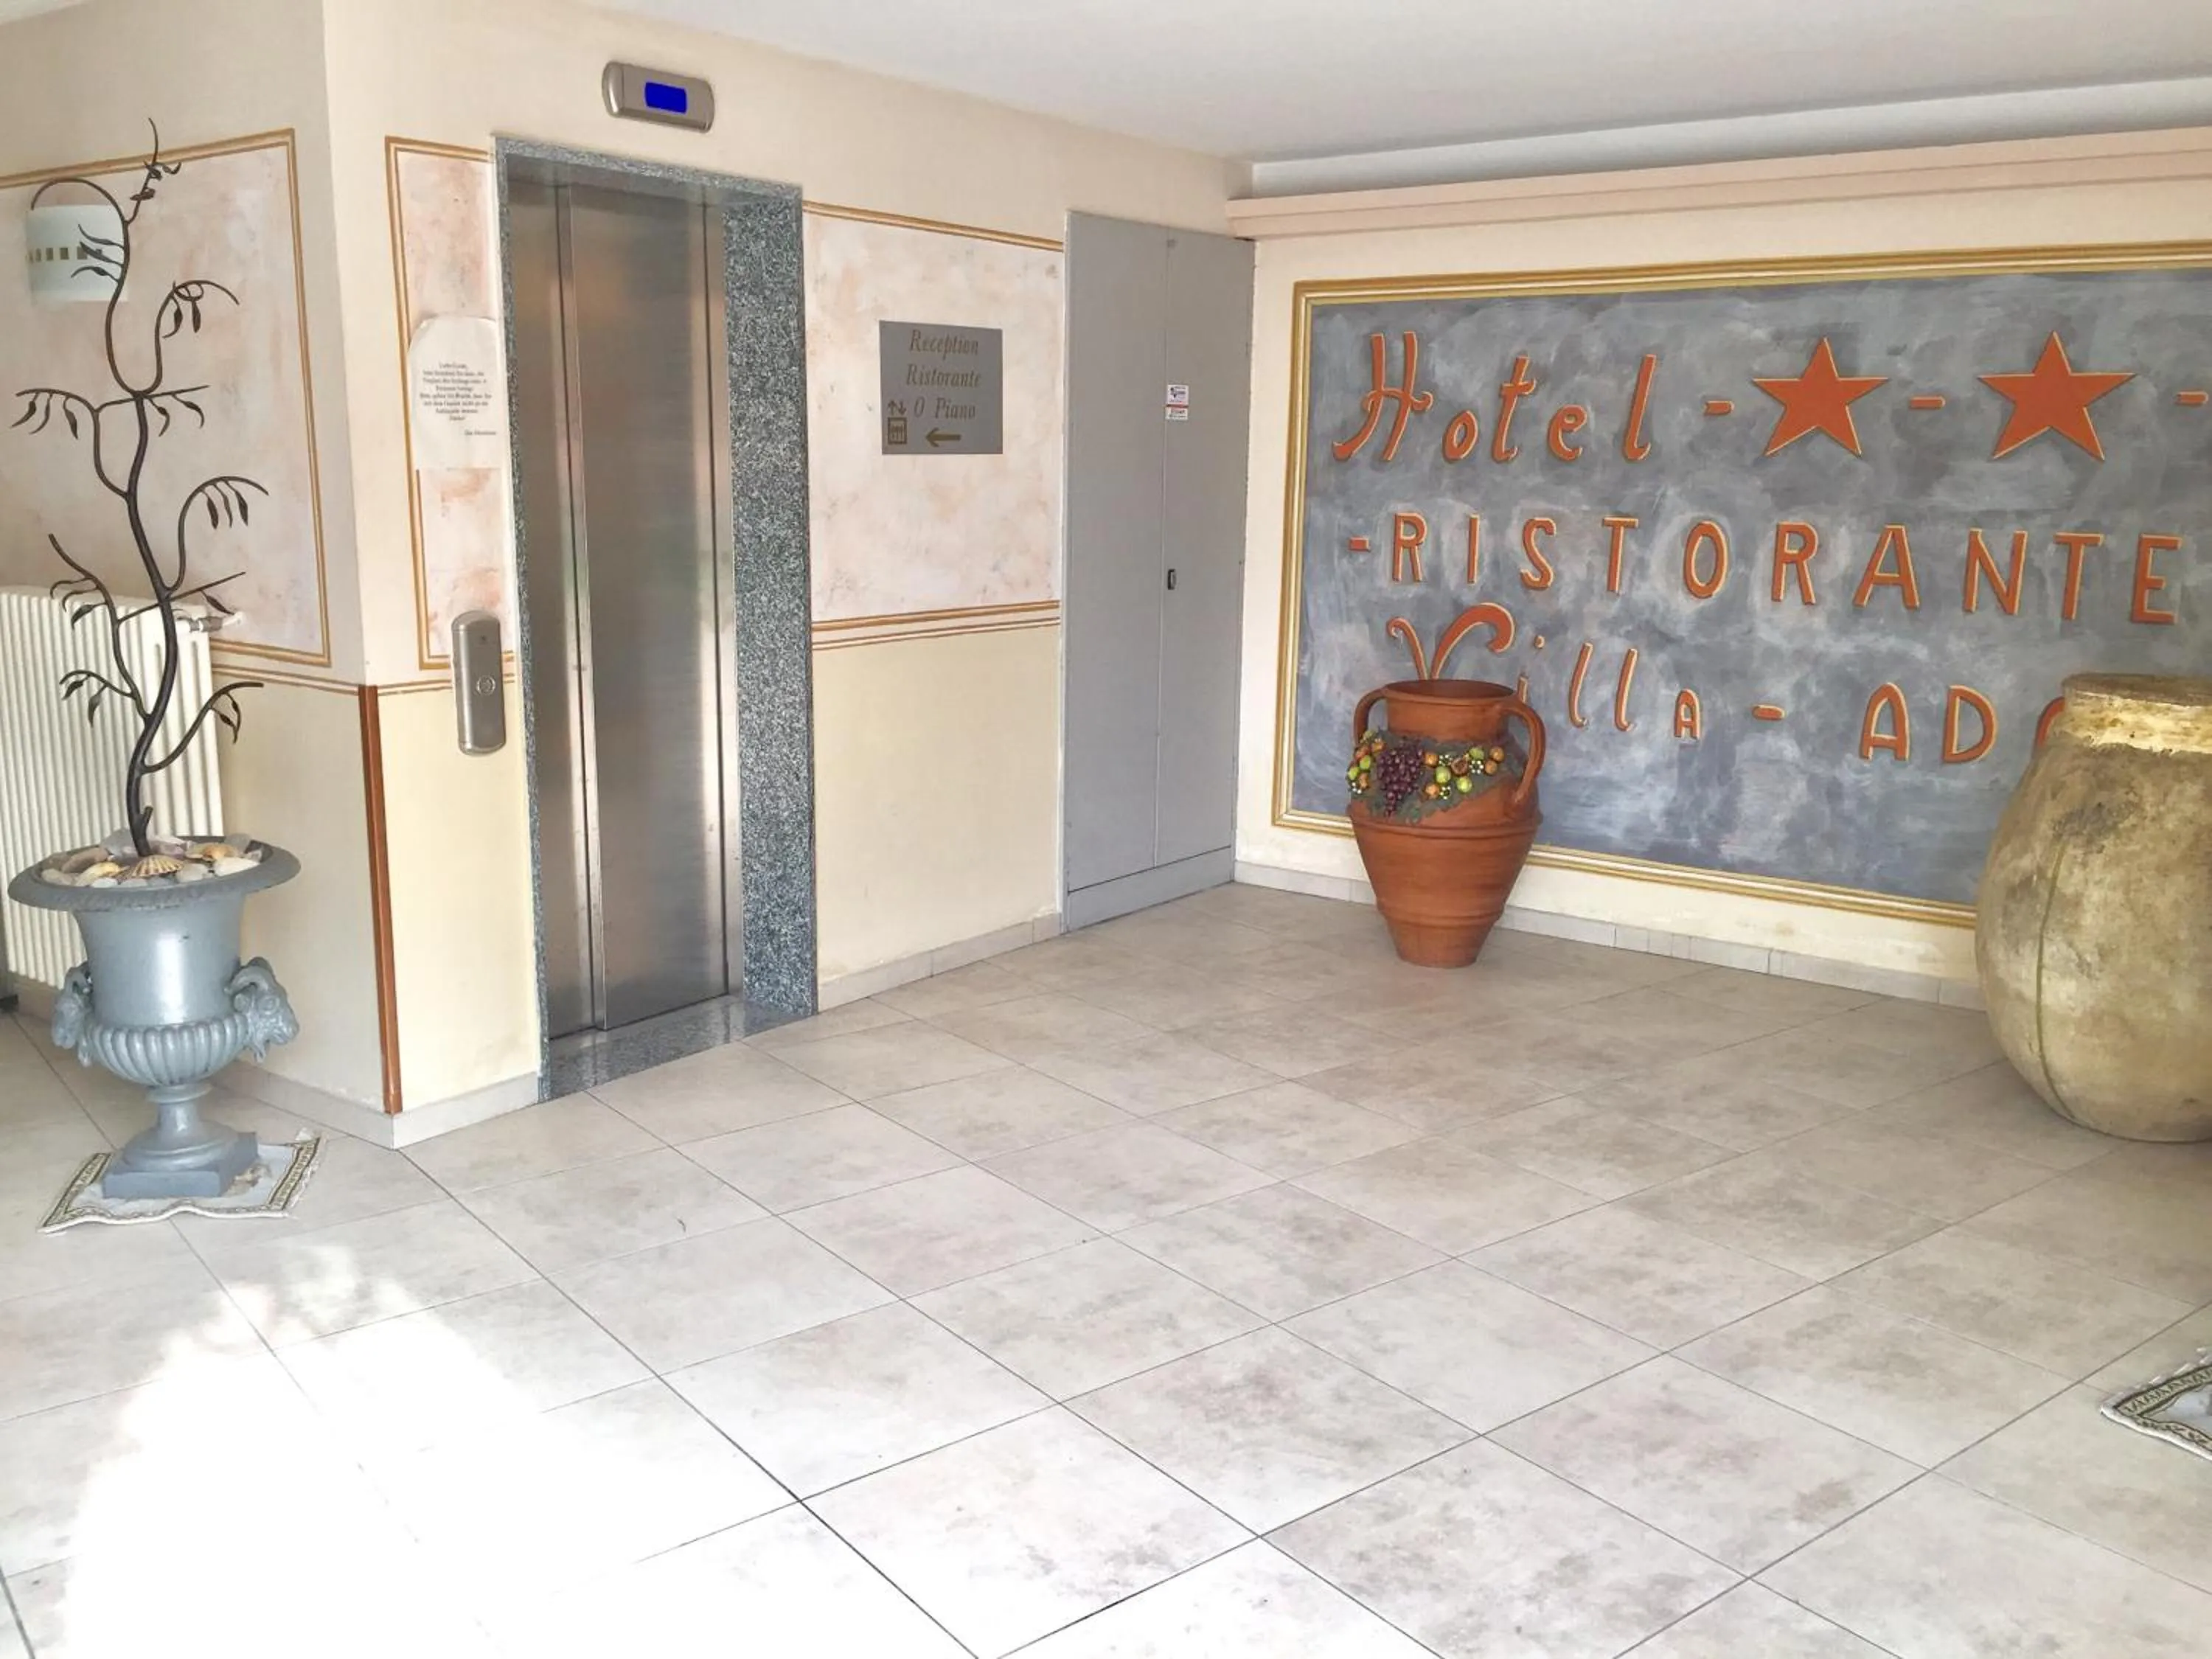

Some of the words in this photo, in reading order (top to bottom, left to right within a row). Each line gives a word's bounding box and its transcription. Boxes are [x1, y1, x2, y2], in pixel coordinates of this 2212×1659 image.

[909, 329, 978, 361] Reception
[906, 364, 981, 388] Ristorante
[935, 397, 976, 421] Piano
[1333, 331, 1657, 462] Hotel
